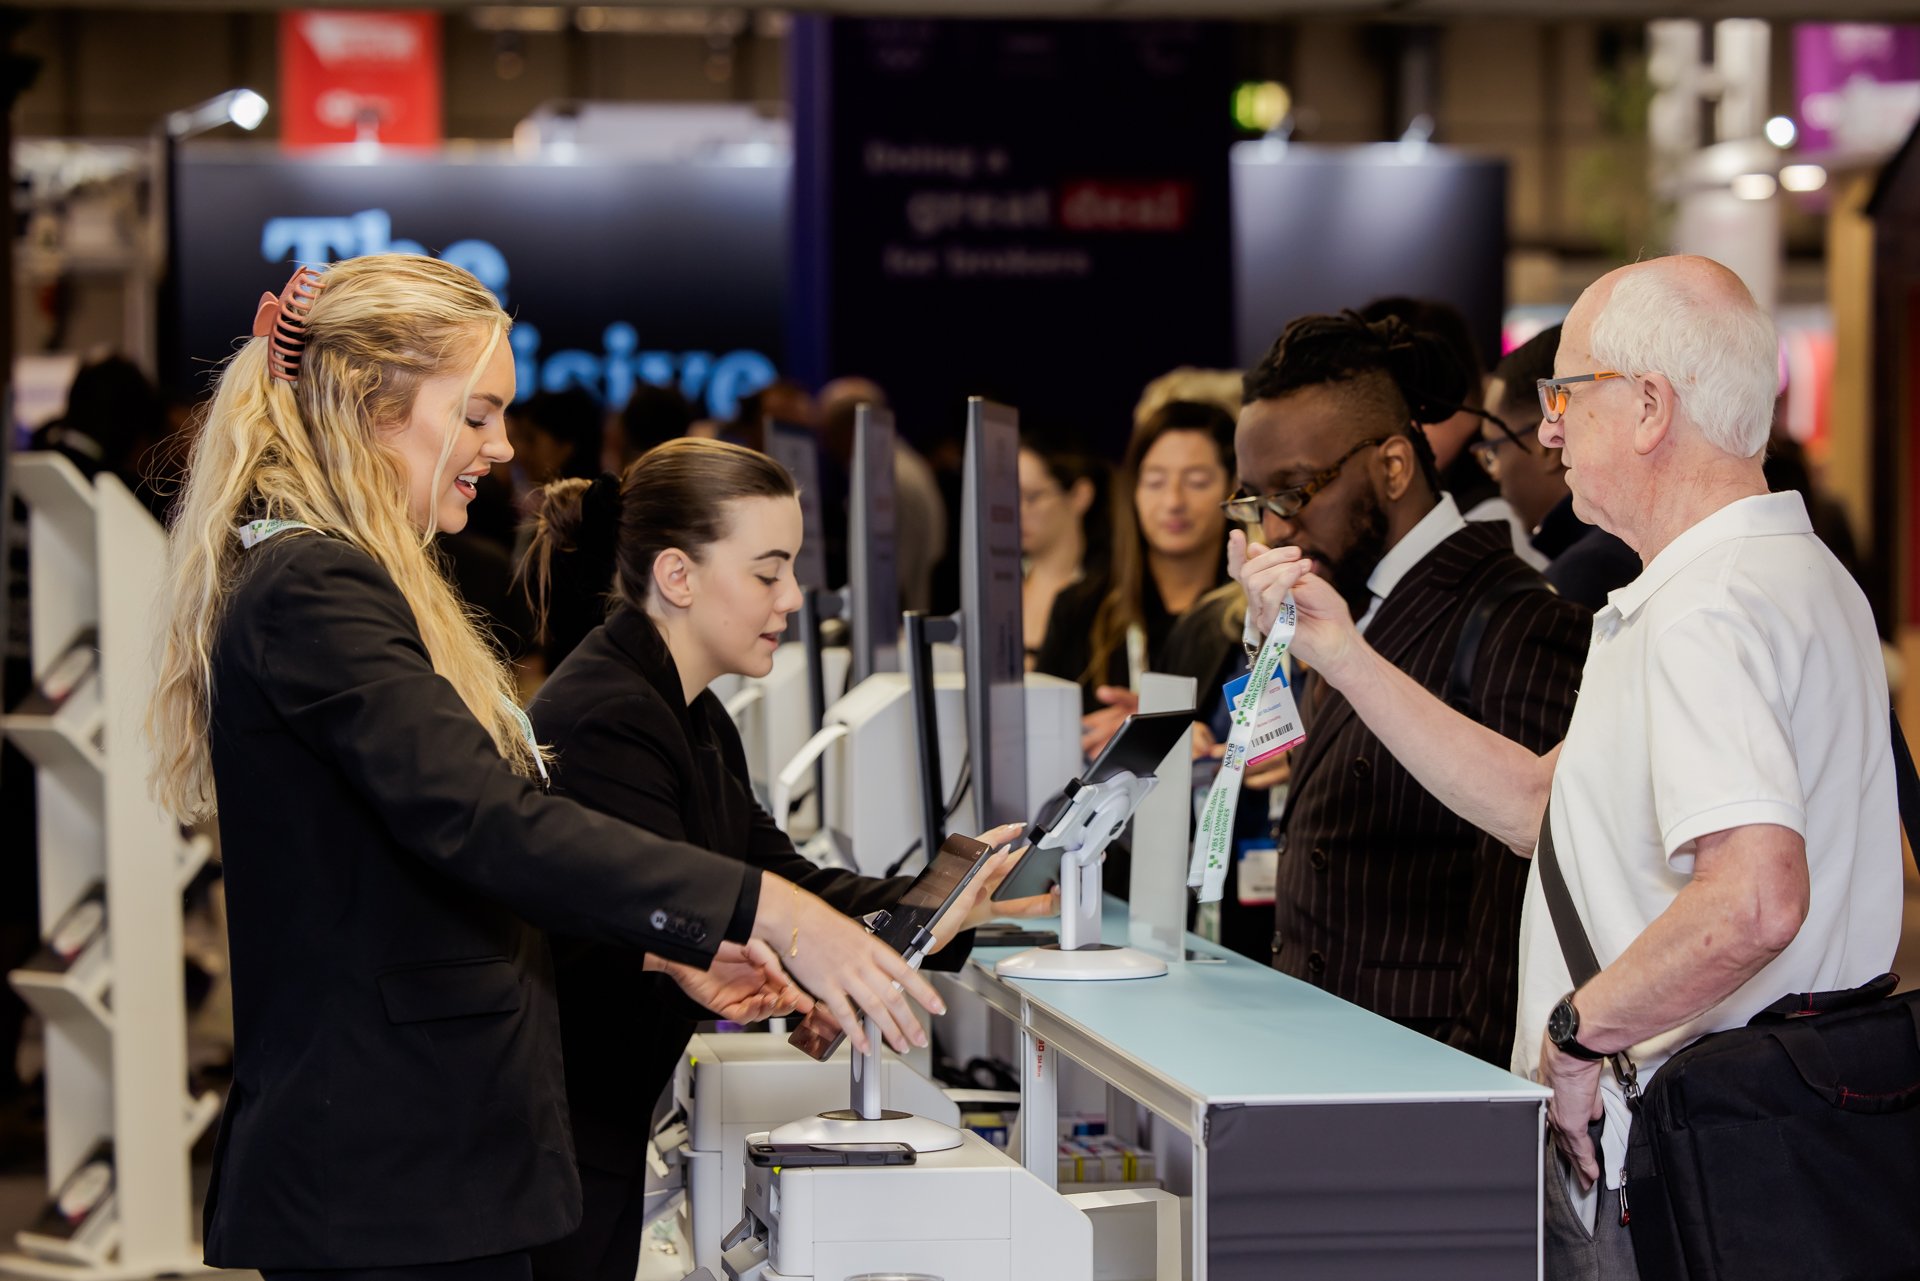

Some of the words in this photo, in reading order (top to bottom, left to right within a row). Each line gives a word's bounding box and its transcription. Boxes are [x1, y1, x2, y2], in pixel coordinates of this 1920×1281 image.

[907, 187, 1050, 236] great
[1063, 185, 1178, 229] deal
[1224, 743, 1235, 768] NACFB
[1214, 787, 1228, 836] COMMERCIAL
[1218, 809, 1230, 854] MORTGAGES
[1211, 838, 1219, 851] YBS
